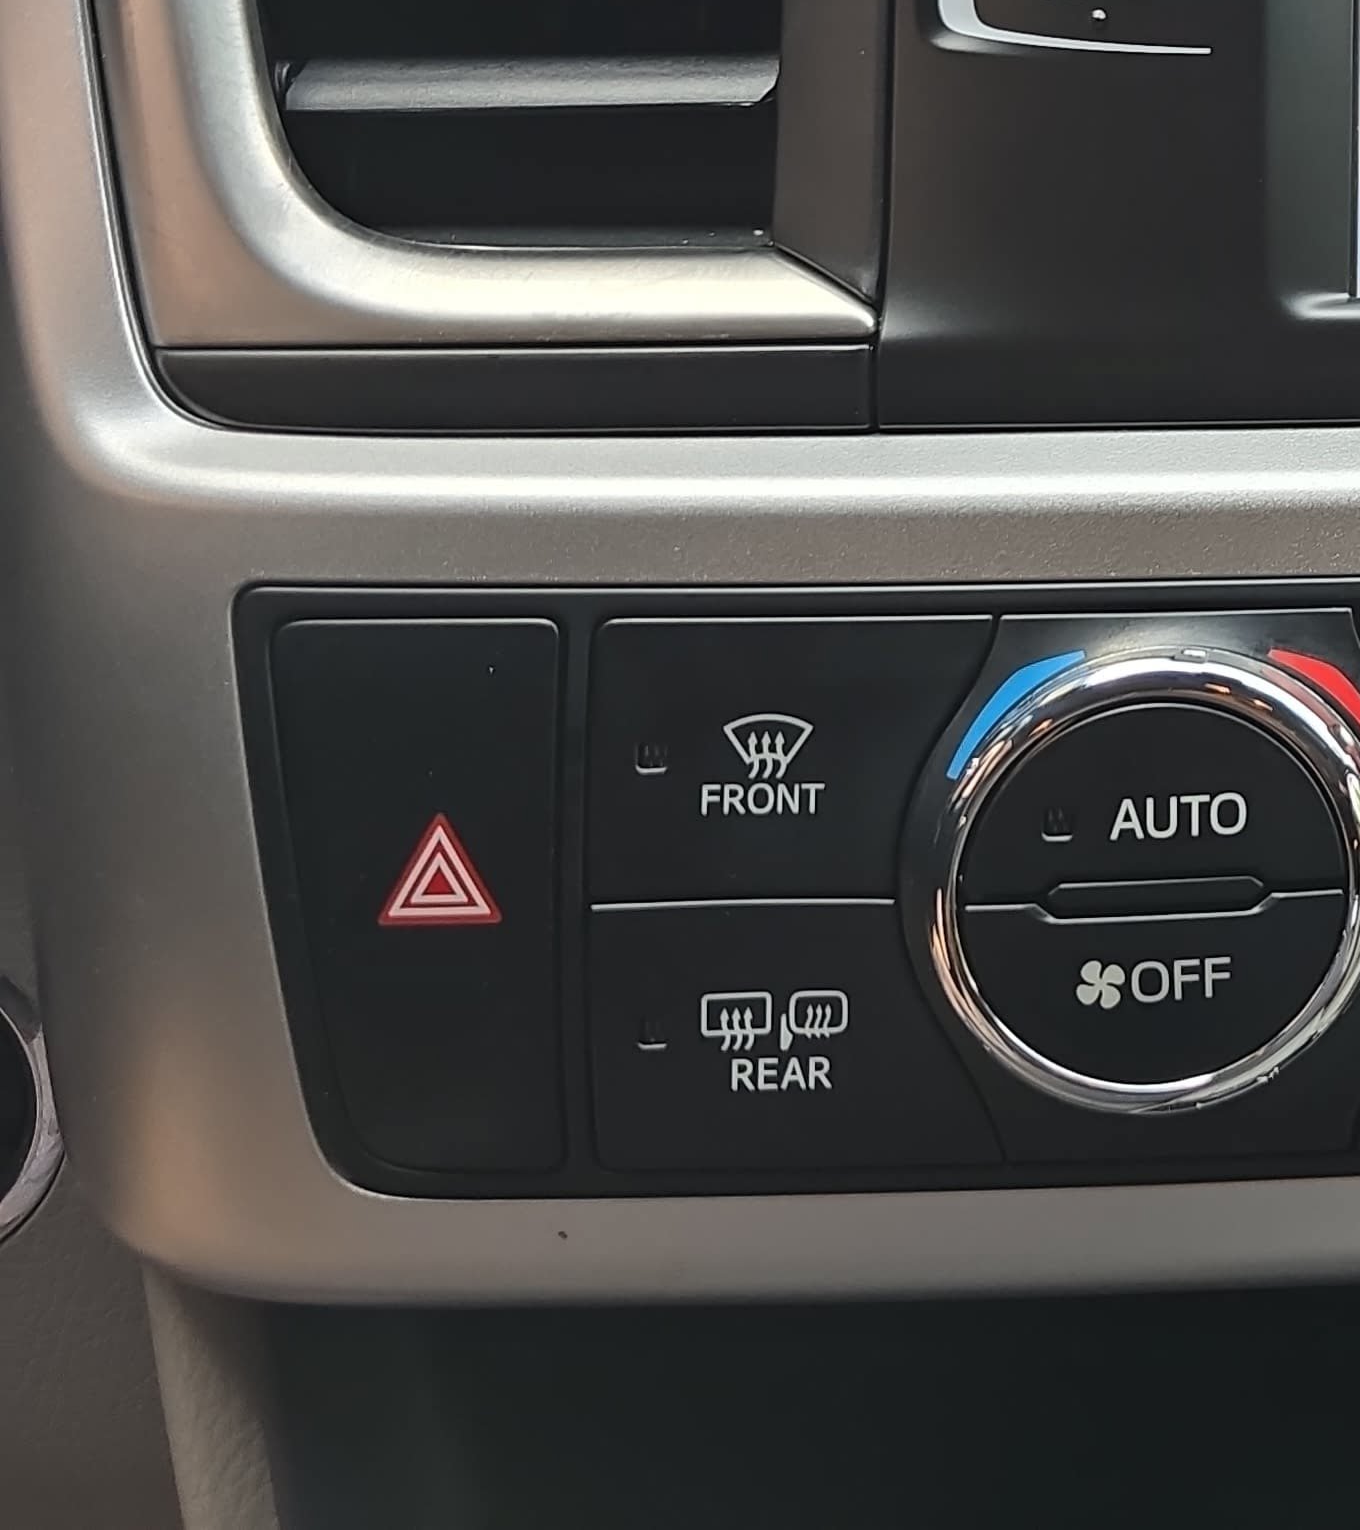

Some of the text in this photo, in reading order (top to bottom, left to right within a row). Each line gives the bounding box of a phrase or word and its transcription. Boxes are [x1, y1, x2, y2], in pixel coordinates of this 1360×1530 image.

[700, 783, 825, 816] FRONT
[1109, 792, 1248, 841] AUTO
[1131, 956, 1232, 1004] OFF
[730, 1058, 833, 1091] REAR
